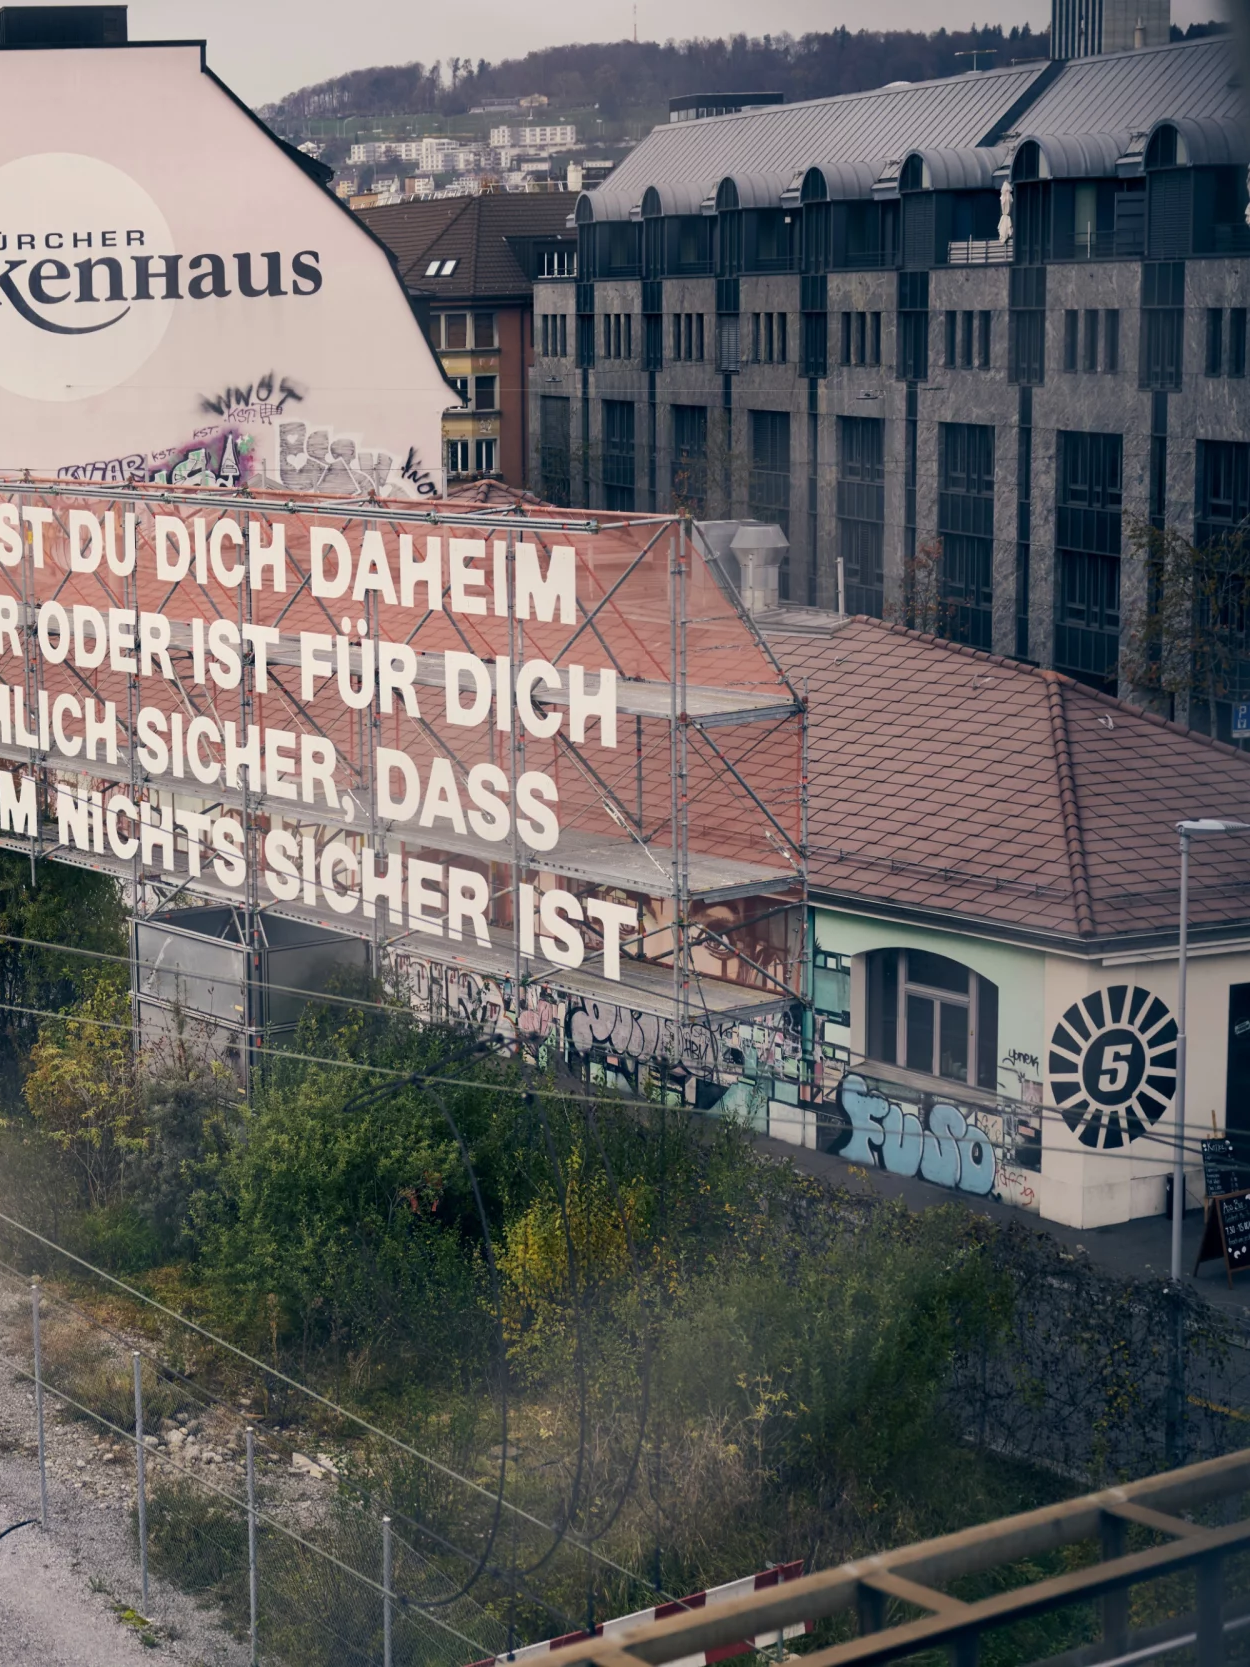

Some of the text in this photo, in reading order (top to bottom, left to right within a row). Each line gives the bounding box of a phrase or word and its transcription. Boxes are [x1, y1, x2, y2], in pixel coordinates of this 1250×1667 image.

[69, 509, 136, 577] DU
[155, 514, 287, 593] DICH
[310, 526, 577, 625] DAHEIM
[38, 600, 175, 680] ODER
[192, 617, 280, 694] IST
[300, 616, 421, 718] FÜR
[445, 650, 617, 748] DICH
[137, 706, 355, 823] SICHER,
[376, 746, 559, 851] DASS
[57, 784, 247, 887] NICHTS
[264, 829, 493, 949] SICHER
[519, 882, 638, 981] IST
[1098, 1043, 1133, 1092] 5
